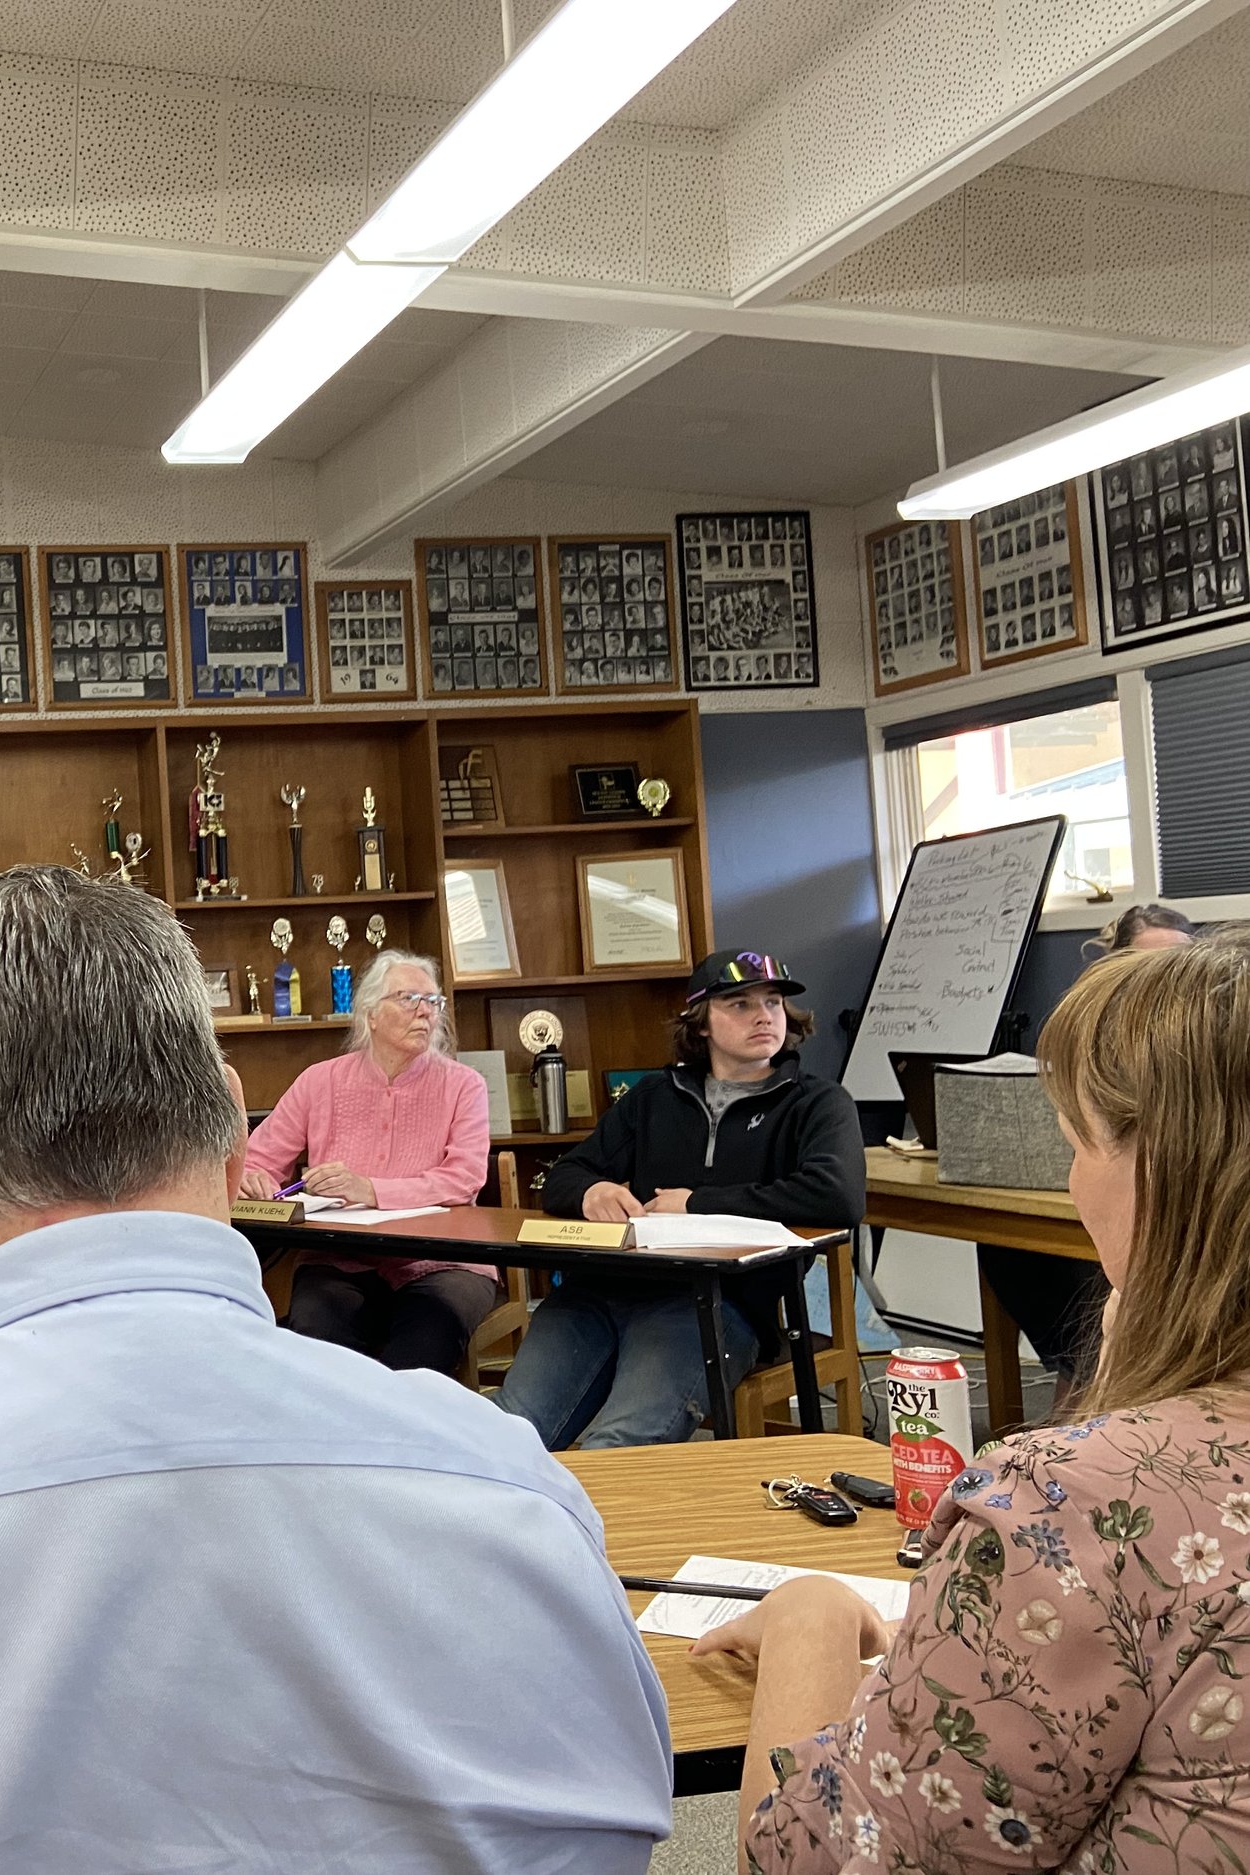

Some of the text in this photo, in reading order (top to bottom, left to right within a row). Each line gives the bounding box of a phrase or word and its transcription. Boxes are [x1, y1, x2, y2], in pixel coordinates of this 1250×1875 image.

[257, 1207, 286, 1216] KUEHL
[560, 1225, 584, 1234] ASB
[908, 1384, 926, 1393] the
[887, 1380, 940, 1417] Ryl
[901, 1420, 929, 1436] tea
[893, 1443, 955, 1464] CED TEA
[908, 1461, 952, 1474] BENEFITS
